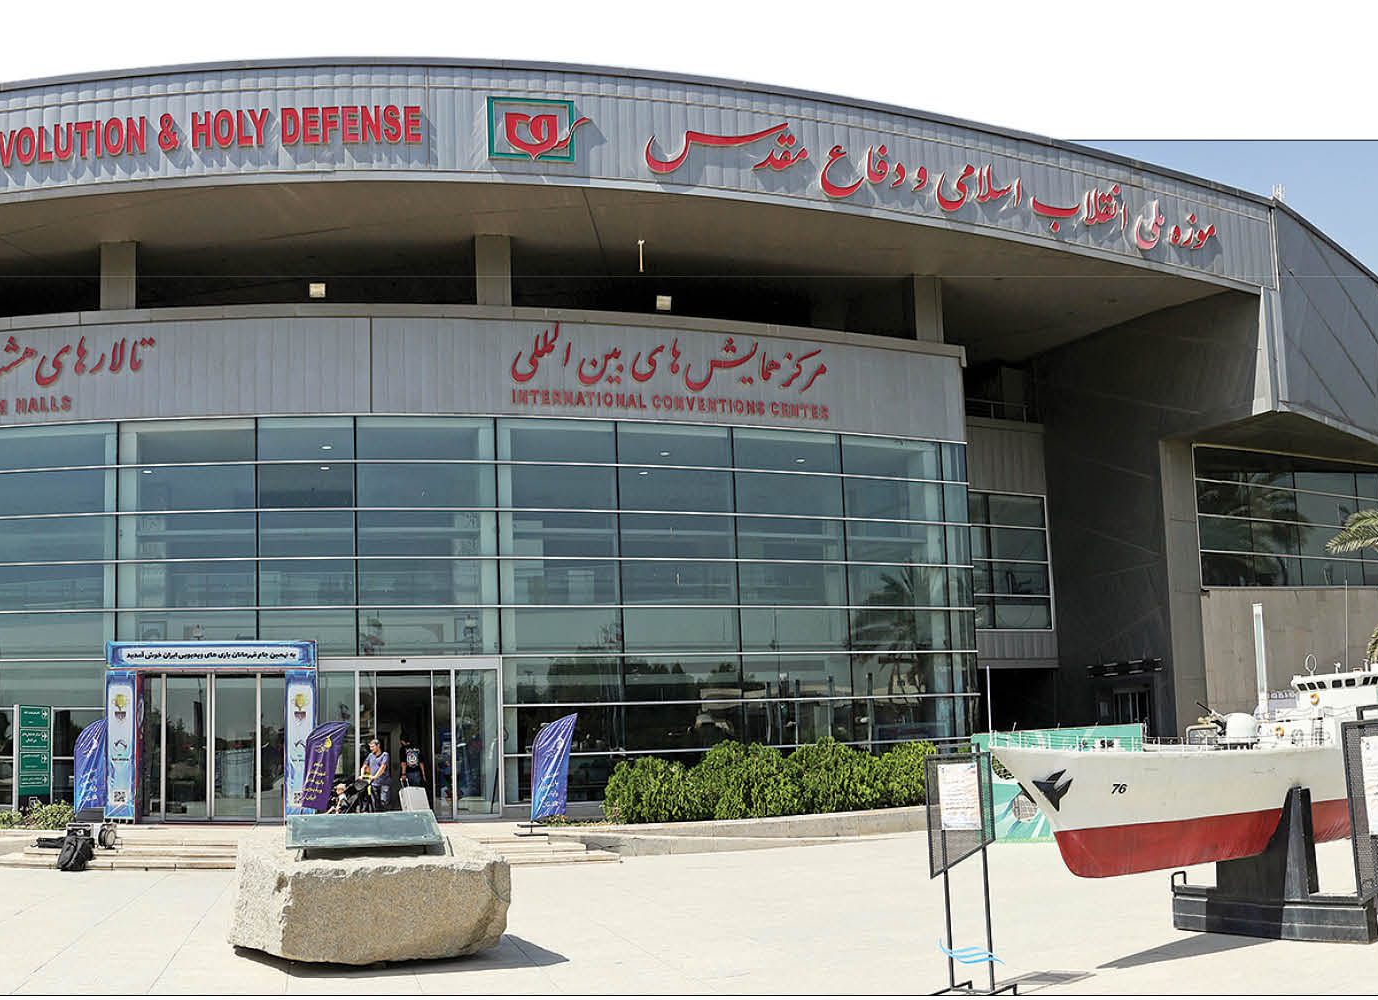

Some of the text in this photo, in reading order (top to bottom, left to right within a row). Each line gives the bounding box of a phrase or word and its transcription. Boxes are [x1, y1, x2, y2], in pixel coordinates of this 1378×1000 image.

[157, 112, 180, 152] &
[191, 107, 270, 150] HOLY
[281, 104, 424, 145] DEFENSE
[644, 122, 1216, 250] موزه ملی انقلاب اسلامی و دفاع مقدس
[510, 321, 572, 383] المللی
[578, 346, 624, 385] بین
[683, 337, 781, 392] همایش
[781, 349, 828, 393] مرکز
[15, 395, 71, 414] HALLS
[511, 389, 830, 420] INTERNATIONAL CONVENTIONS CENTER
[1111, 783, 1128, 795] 76
